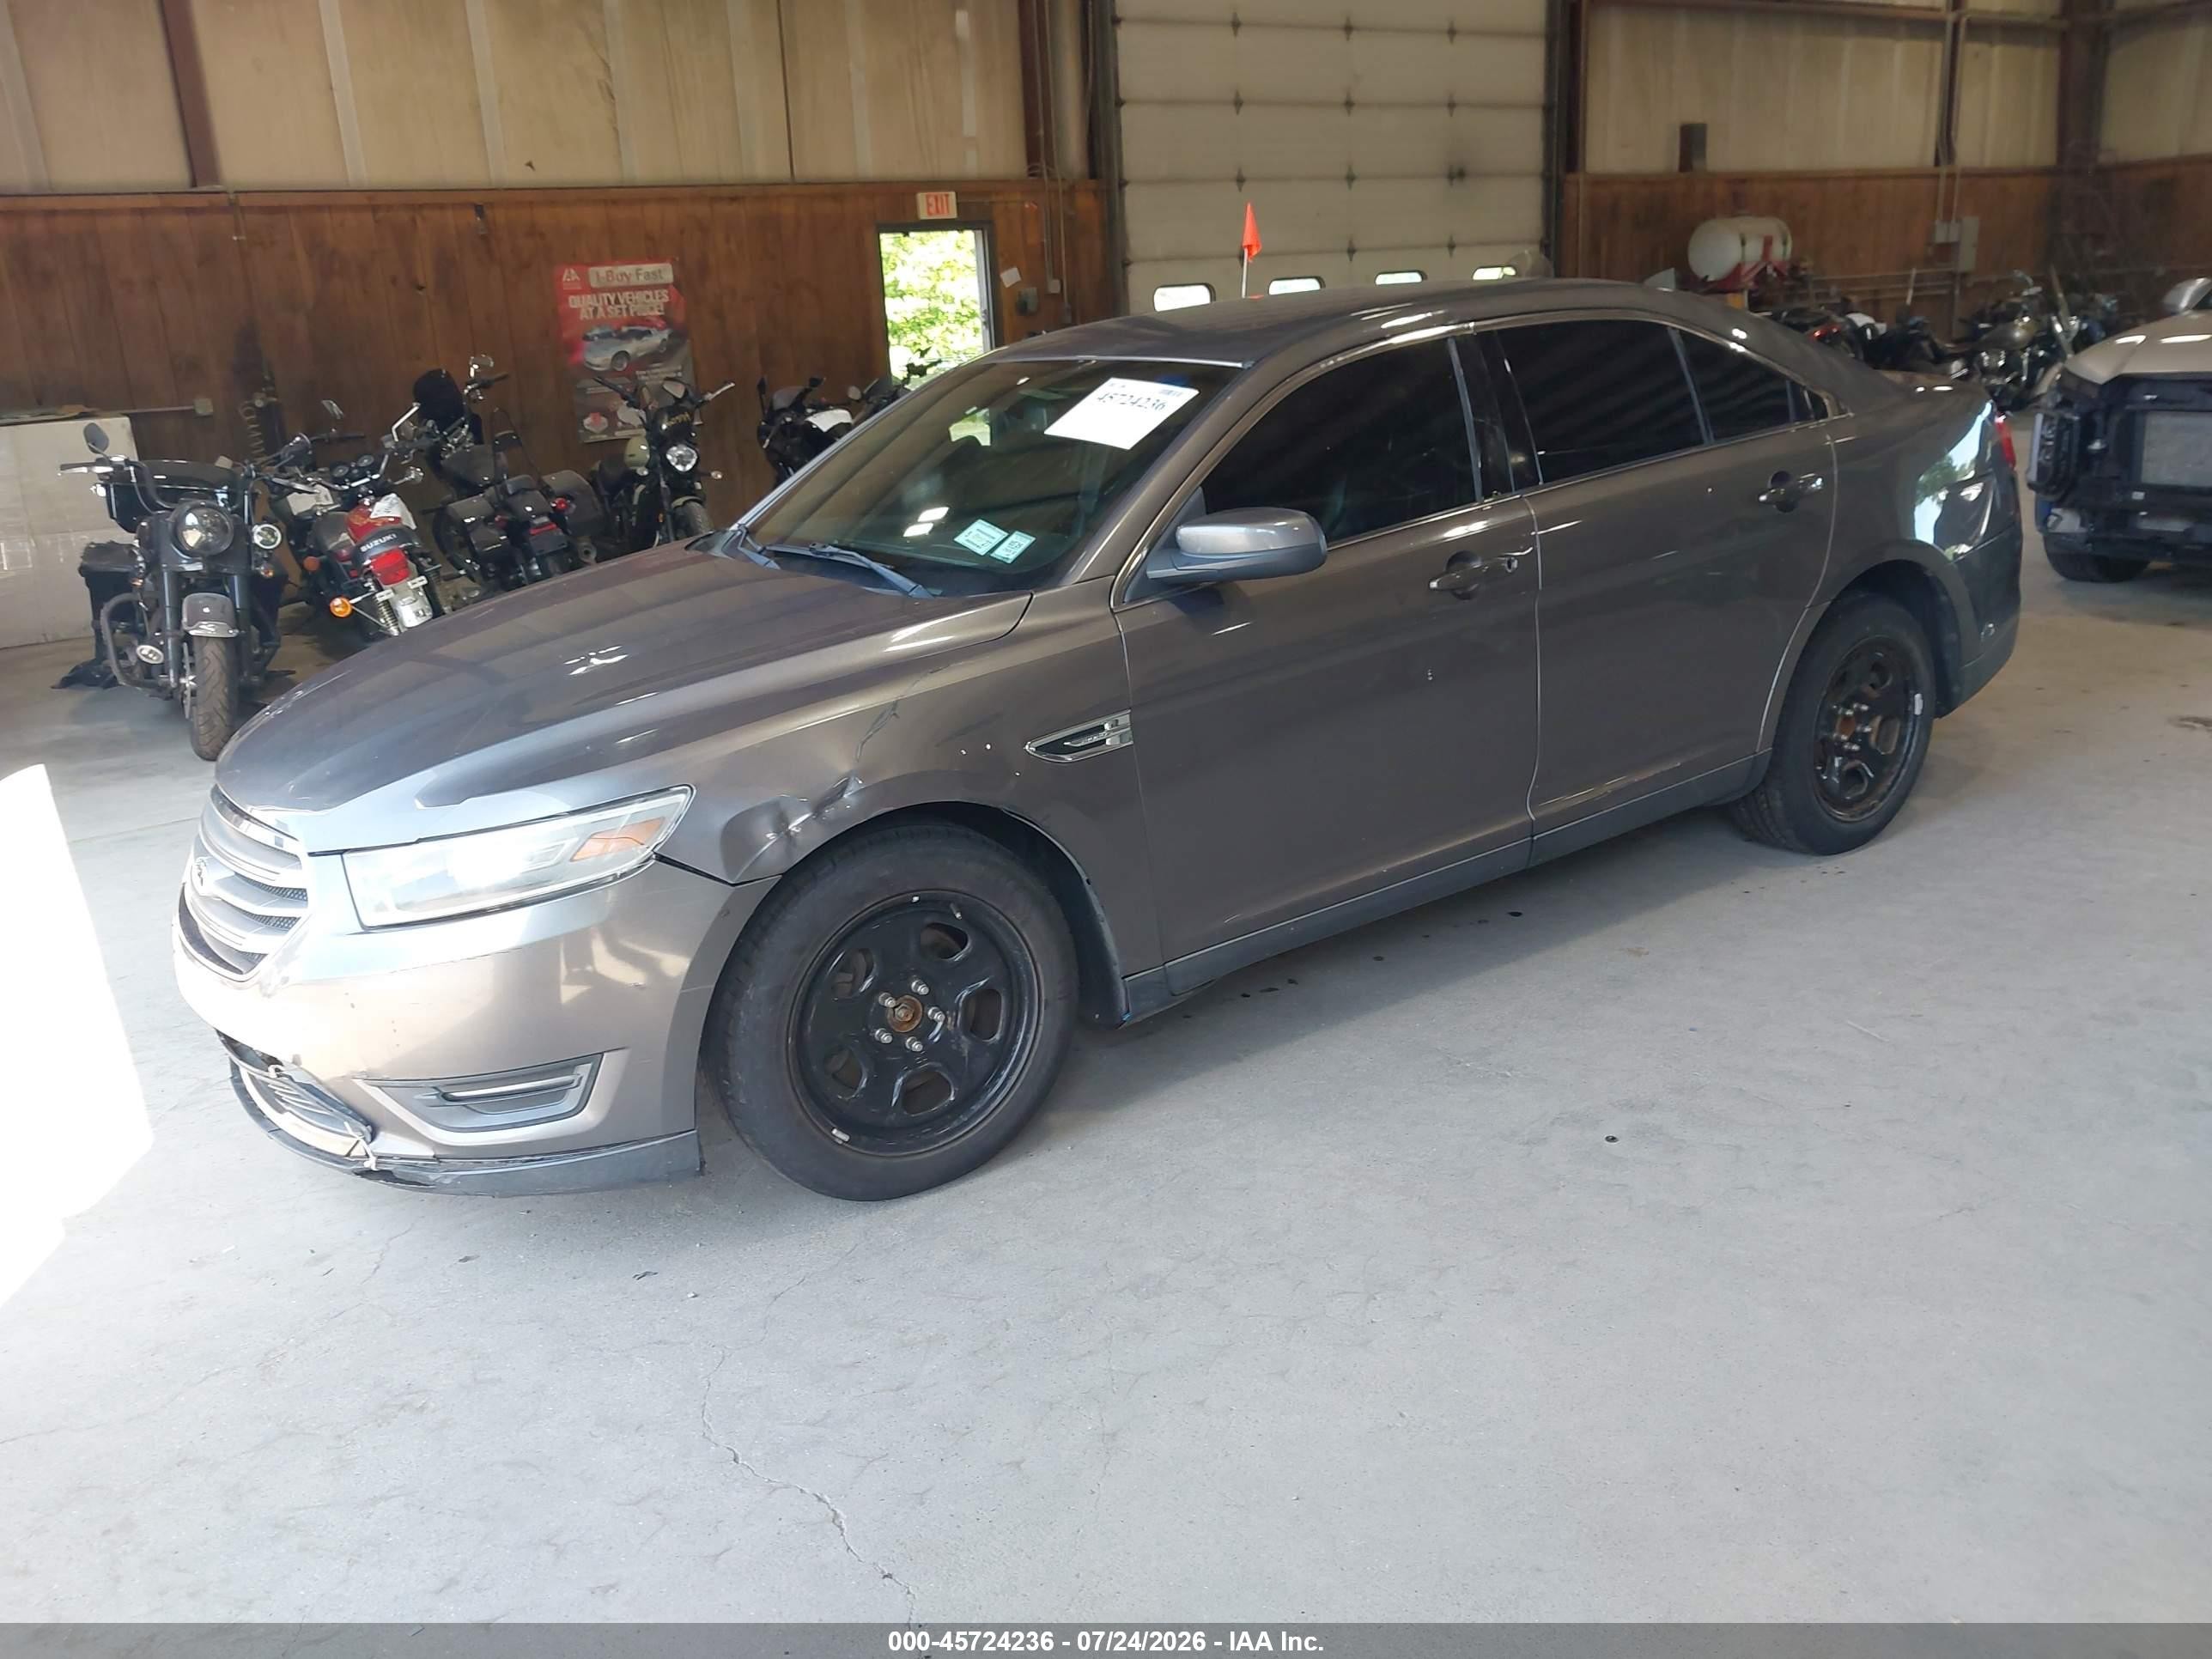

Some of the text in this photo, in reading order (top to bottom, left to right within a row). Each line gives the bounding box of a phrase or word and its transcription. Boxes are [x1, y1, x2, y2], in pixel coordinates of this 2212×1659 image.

[926, 194, 949, 216] EXIT
[635, 267, 664, 281] Fast
[568, 289, 670, 308] QUALITY VEHICLES
[580, 307, 596, 320] AT
[596, 306, 606, 319] A
[607, 305, 628, 318] SET
[360, 533, 398, 552] SUZUKI
